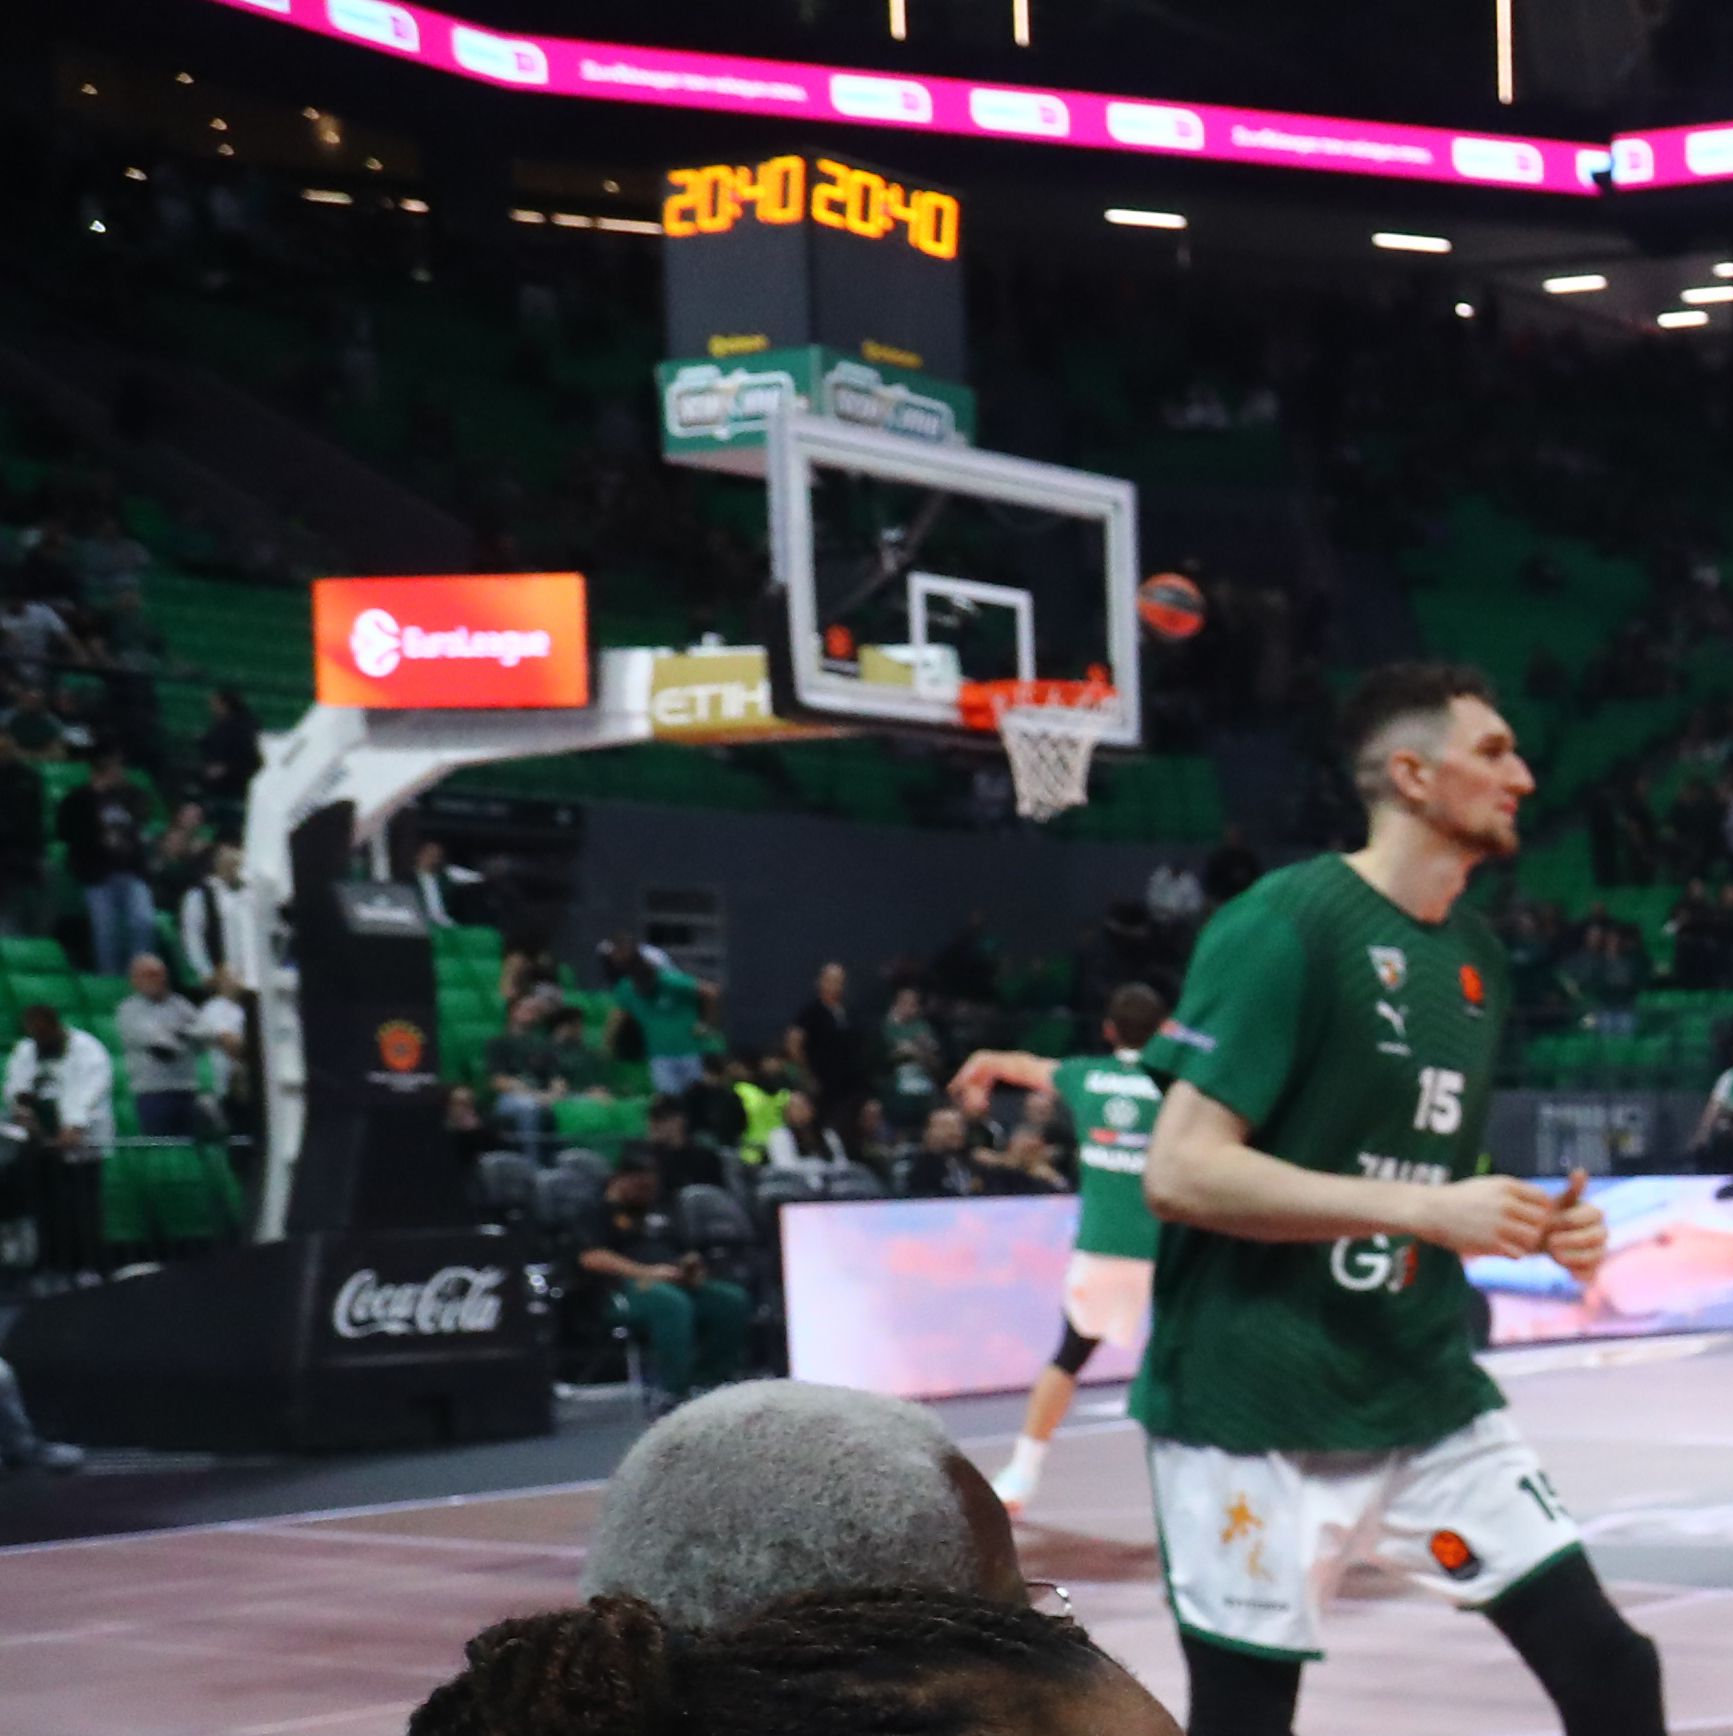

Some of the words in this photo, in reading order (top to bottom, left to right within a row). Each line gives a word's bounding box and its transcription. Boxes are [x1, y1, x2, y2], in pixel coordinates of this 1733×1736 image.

[662, 155, 806, 238] 20:40
[811, 158, 960, 261] 20:40
[1413, 1066, 1465, 1134] 15
